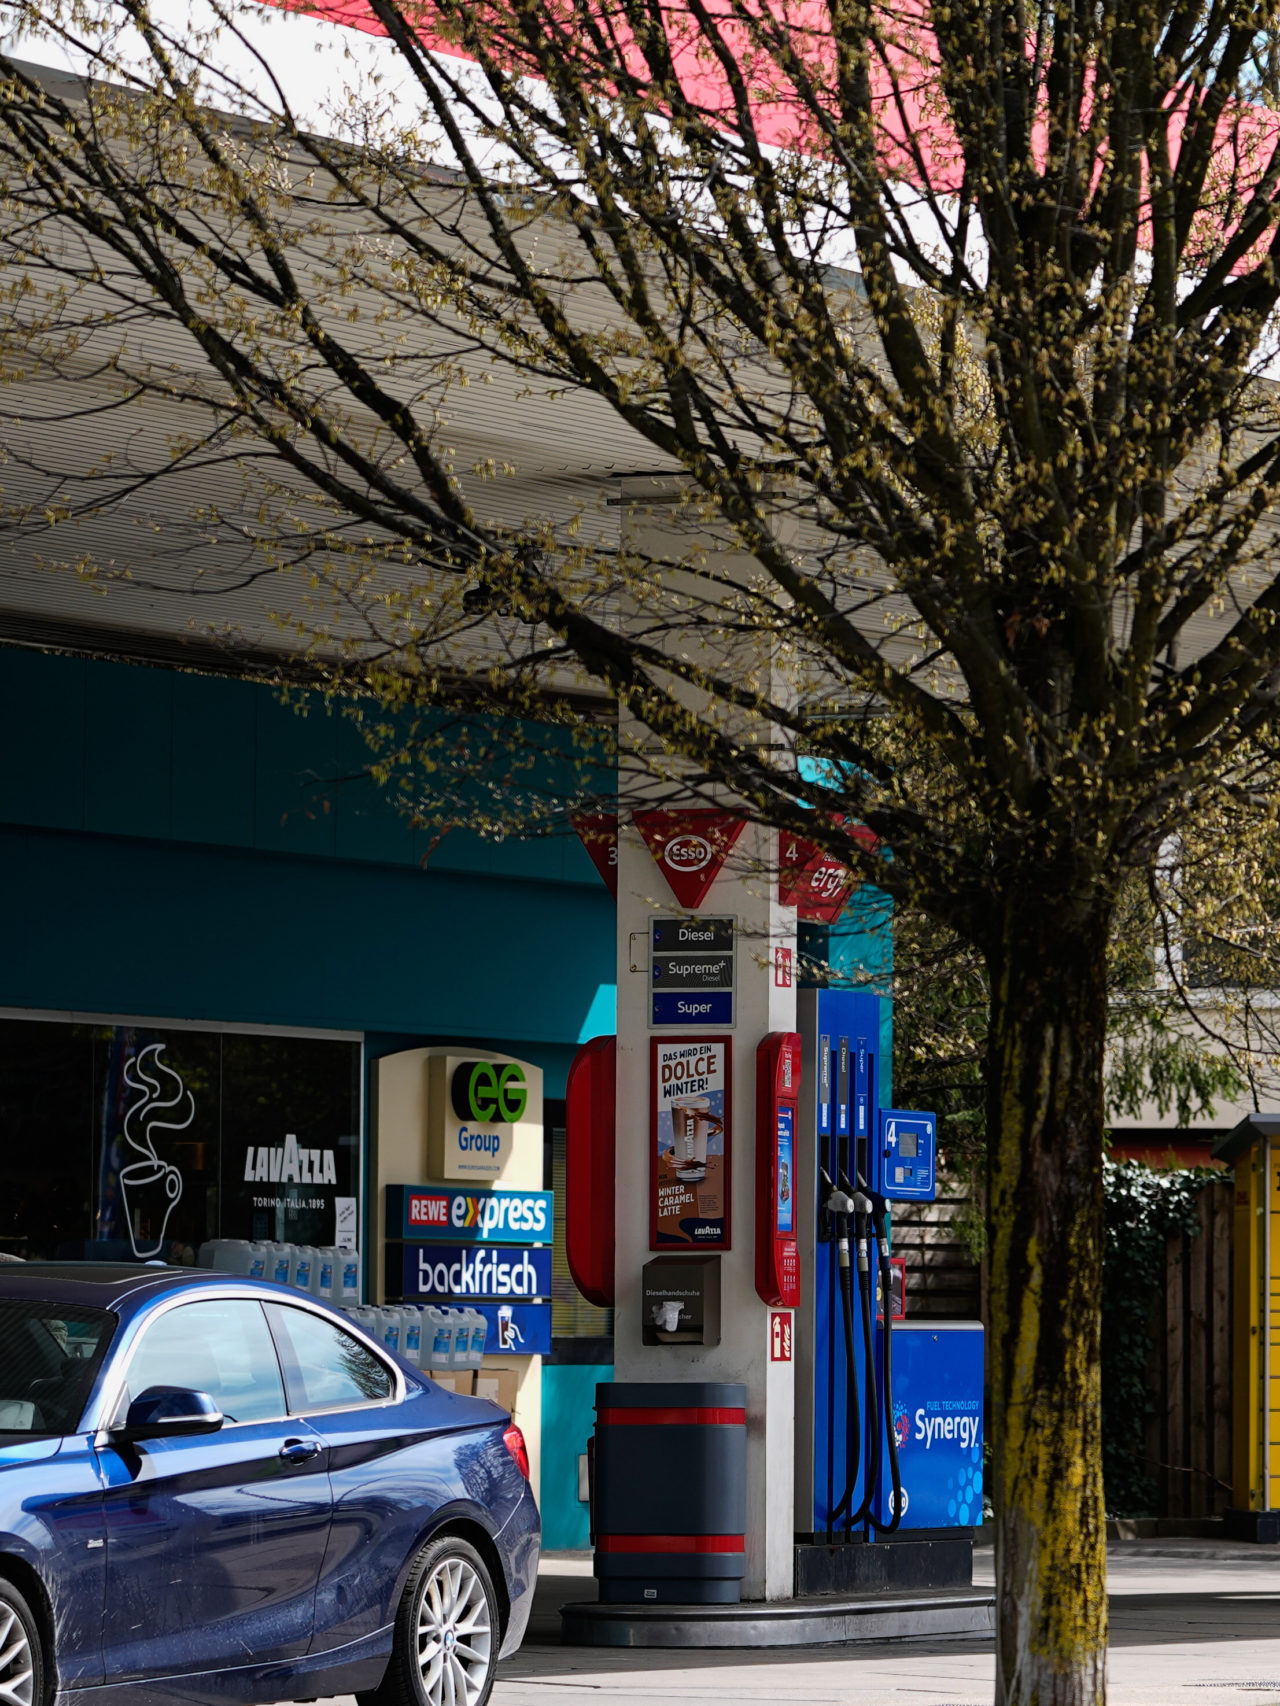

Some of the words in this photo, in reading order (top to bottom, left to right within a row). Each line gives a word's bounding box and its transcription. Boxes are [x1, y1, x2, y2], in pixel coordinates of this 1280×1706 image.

[608, 846, 618, 866] 3
[672, 845, 706, 861] Esso
[785, 843, 799, 861] 4
[678, 928, 714, 941] Diesel
[677, 1001, 713, 1016] Super
[663, 1052, 678, 1063] DAS
[679, 1047, 698, 1060] WIRD
[699, 1044, 712, 1055] EIN
[661, 1054, 717, 1084] DOLCE
[663, 1077, 709, 1099] WINTER!
[458, 1126, 500, 1157] Group
[887, 1121, 897, 1148] 4
[244, 1133, 337, 1185] LAVAZZA
[658, 1184, 685, 1197] WINTER
[658, 1193, 695, 1207] CARAMEL
[411, 1199, 448, 1221] REWE
[451, 1195, 547, 1239] express
[658, 1205, 681, 1217] LATTE
[418, 1248, 537, 1295] backfrisch
[926, 1401, 941, 1411] FUEL
[942, 1400, 980, 1411] TECHNOLOGY
[915, 1408, 980, 1449] Synergy
